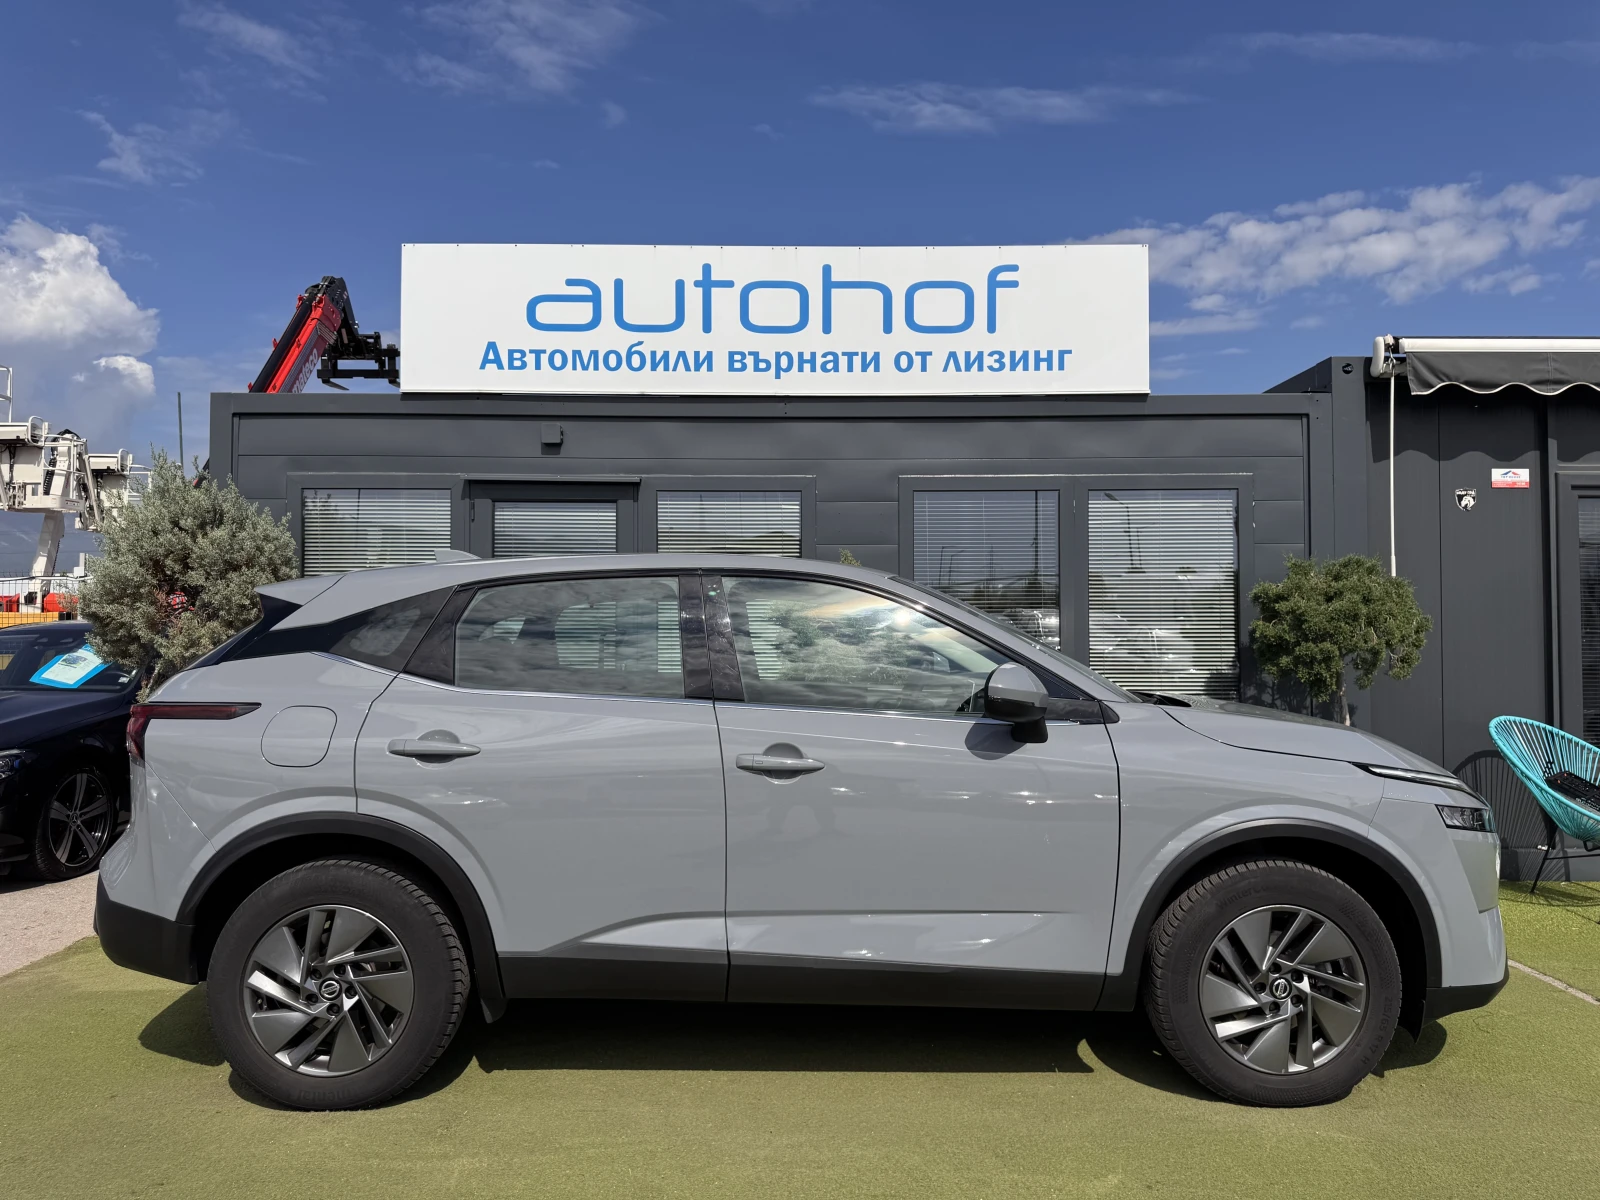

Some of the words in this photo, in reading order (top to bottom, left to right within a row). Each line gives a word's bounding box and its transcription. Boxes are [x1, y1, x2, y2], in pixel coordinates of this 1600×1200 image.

[525, 263, 1020, 335] autohof
[479, 341, 714, 373] Автомобили
[727, 350, 881, 380] върнати
[893, 350, 933, 373] от
[942, 349, 1073, 373] лизинг
